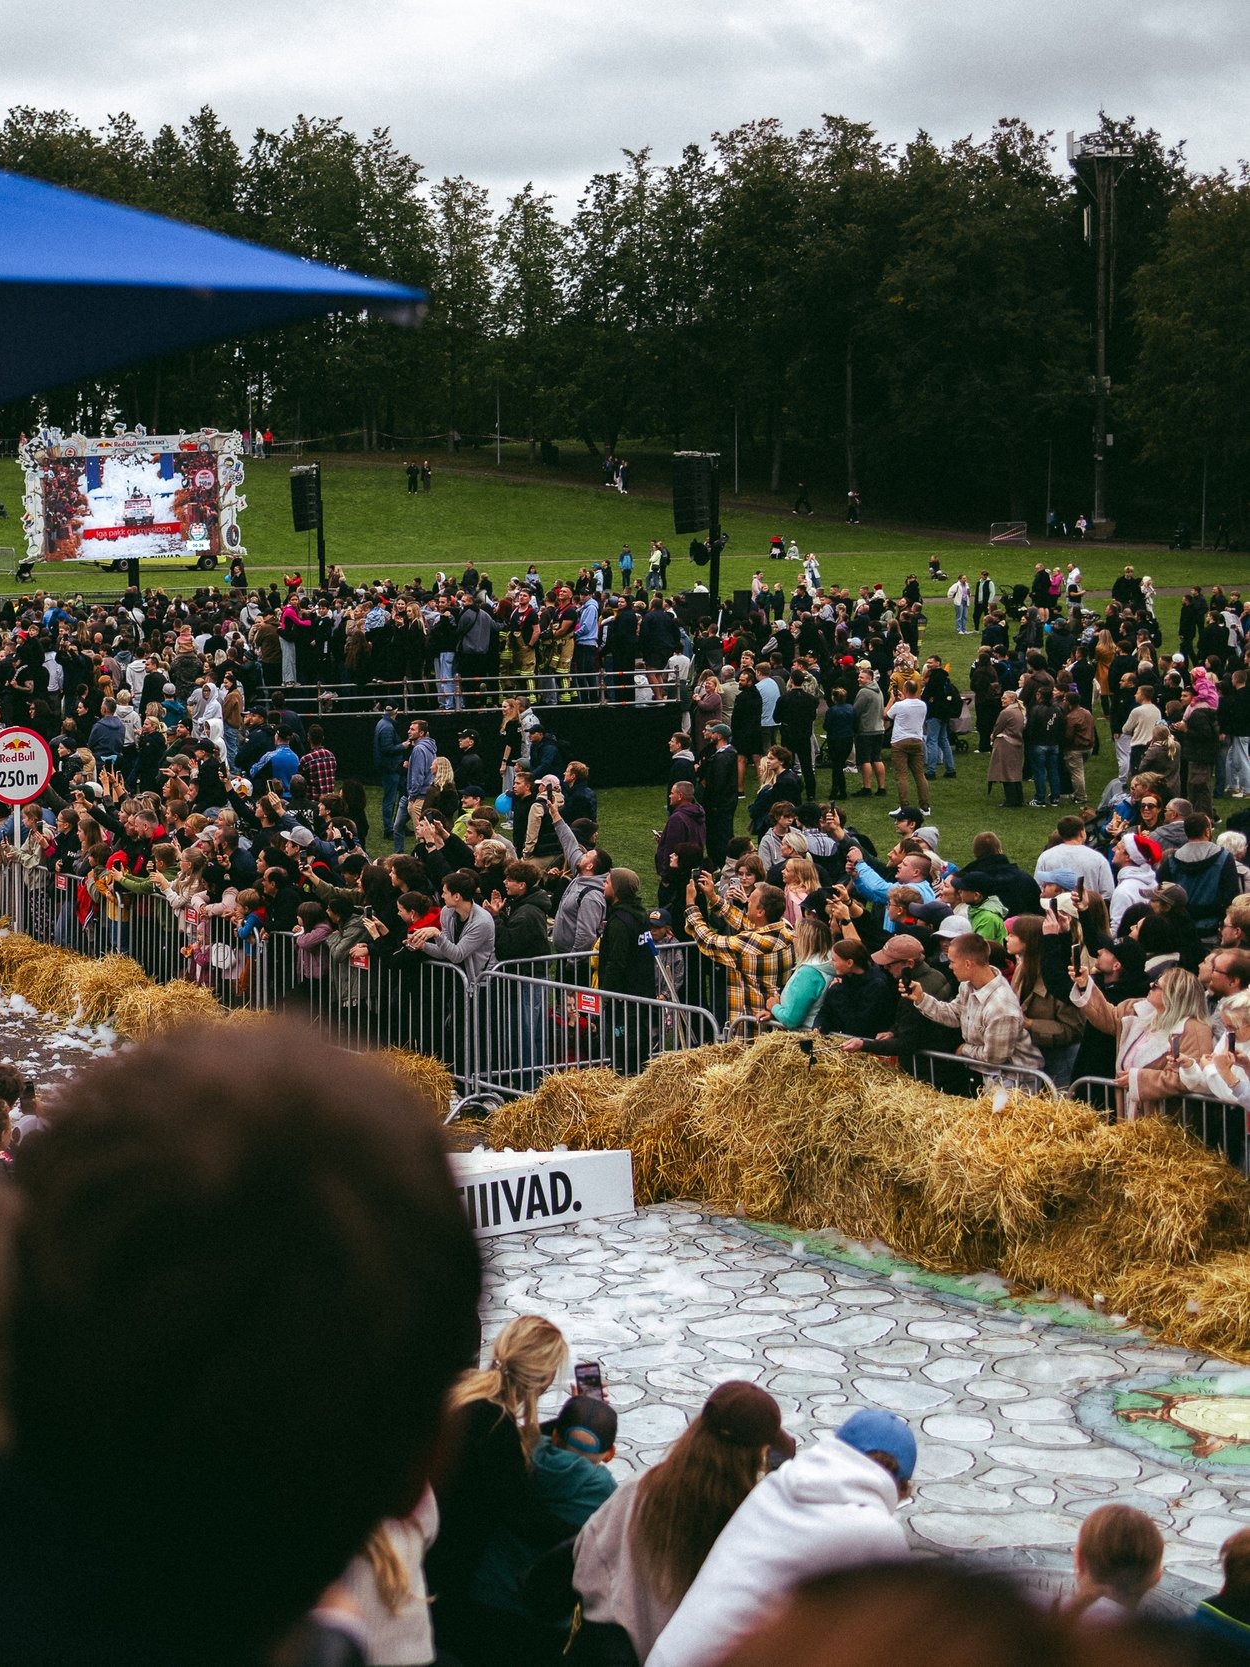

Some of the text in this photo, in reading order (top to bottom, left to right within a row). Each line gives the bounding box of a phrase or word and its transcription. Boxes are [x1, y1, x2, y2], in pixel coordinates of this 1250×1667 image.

[0, 751, 35, 763] Red Bull
[457, 1171, 582, 1230] IIIVAD.
